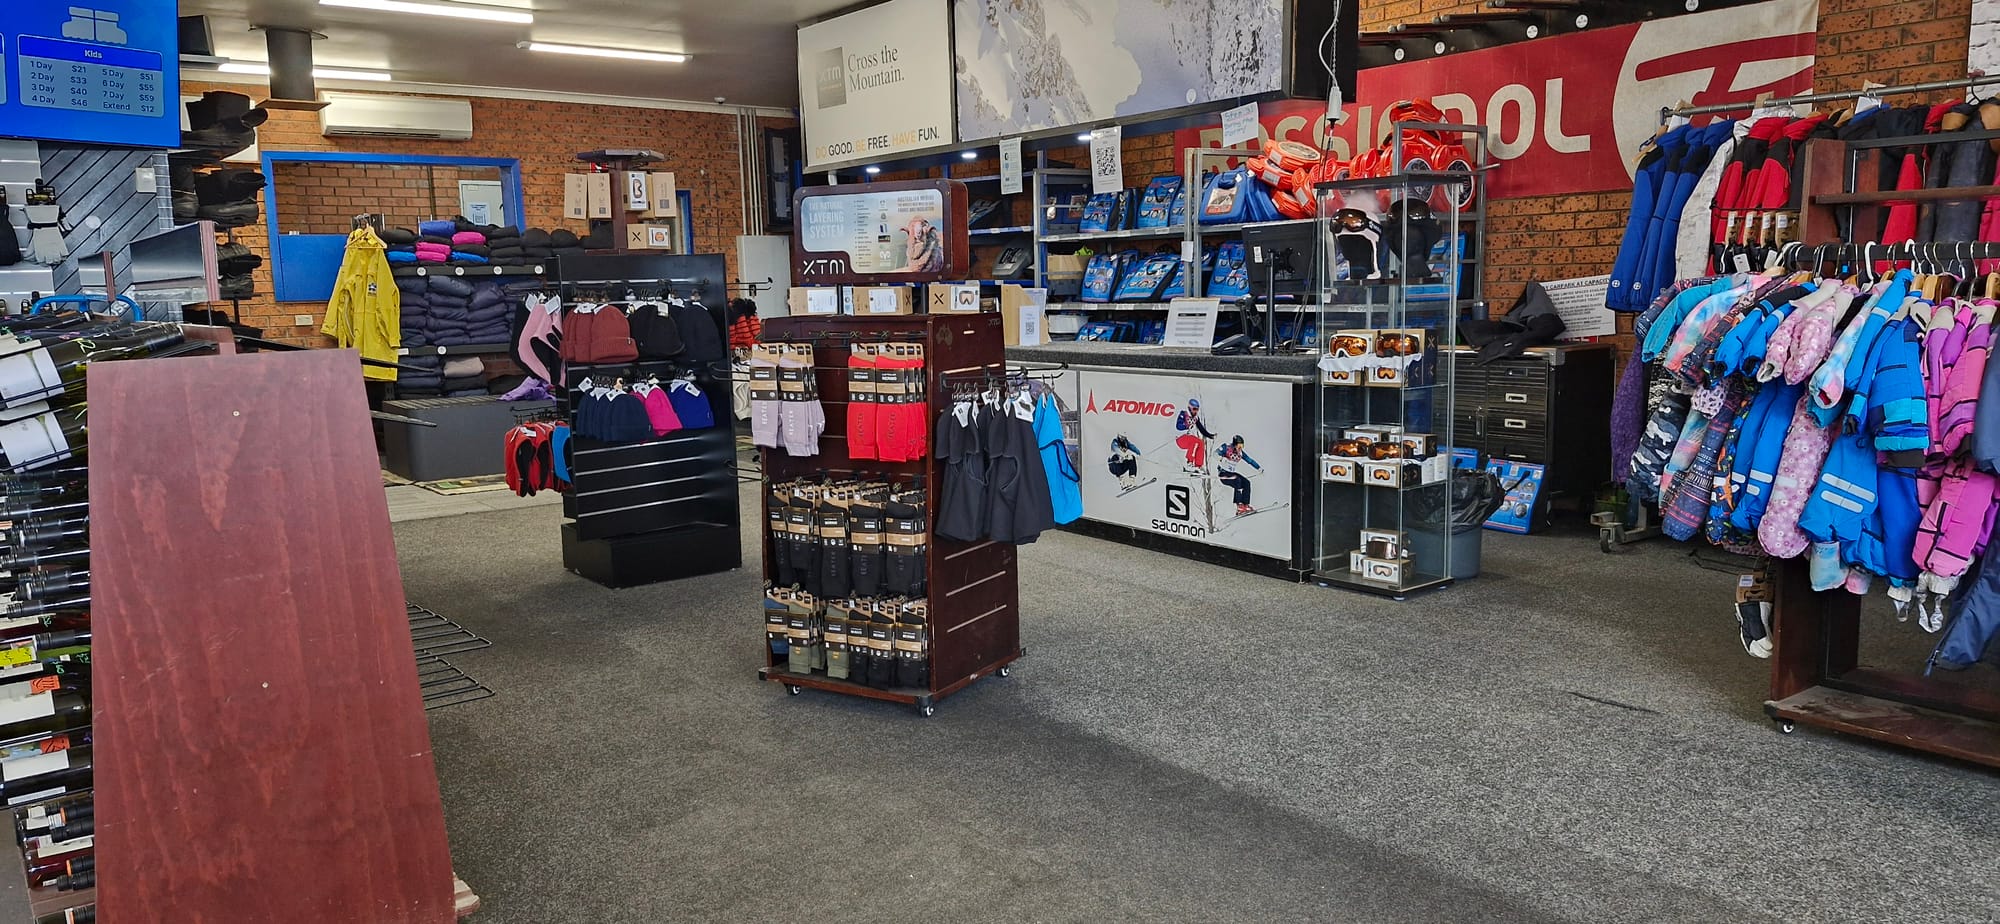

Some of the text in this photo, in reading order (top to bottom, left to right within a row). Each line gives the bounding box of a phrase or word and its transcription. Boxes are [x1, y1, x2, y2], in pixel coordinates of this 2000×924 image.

[84, 49, 103, 59] Kids
[847, 45, 898, 72] Cross the
[30, 60, 34, 68] 1
[36, 61, 53, 71] Day
[31, 71, 37, 79] 2
[38, 72, 55, 82] Day
[102, 68, 107, 76] 5
[109, 69, 124, 79] Day
[849, 65, 905, 93] Mountain.
[31, 83, 37, 91] 3
[38, 84, 55, 94] Day
[102, 79, 108, 87] 6
[109, 80, 124, 90] Day
[39, 96, 56, 105] Day
[109, 91, 124, 101] Day
[103, 102, 131, 111] Extend
[815, 126, 940, 159] DO GOOD. BE FREE. HAVE FUN.
[809, 211, 844, 223] LAYERING
[809, 224, 844, 239] SYSTEM
[803, 259, 845, 275] XTM
[1102, 399, 1176, 417] ATOMIC
[1151, 519, 1206, 539] salomon
